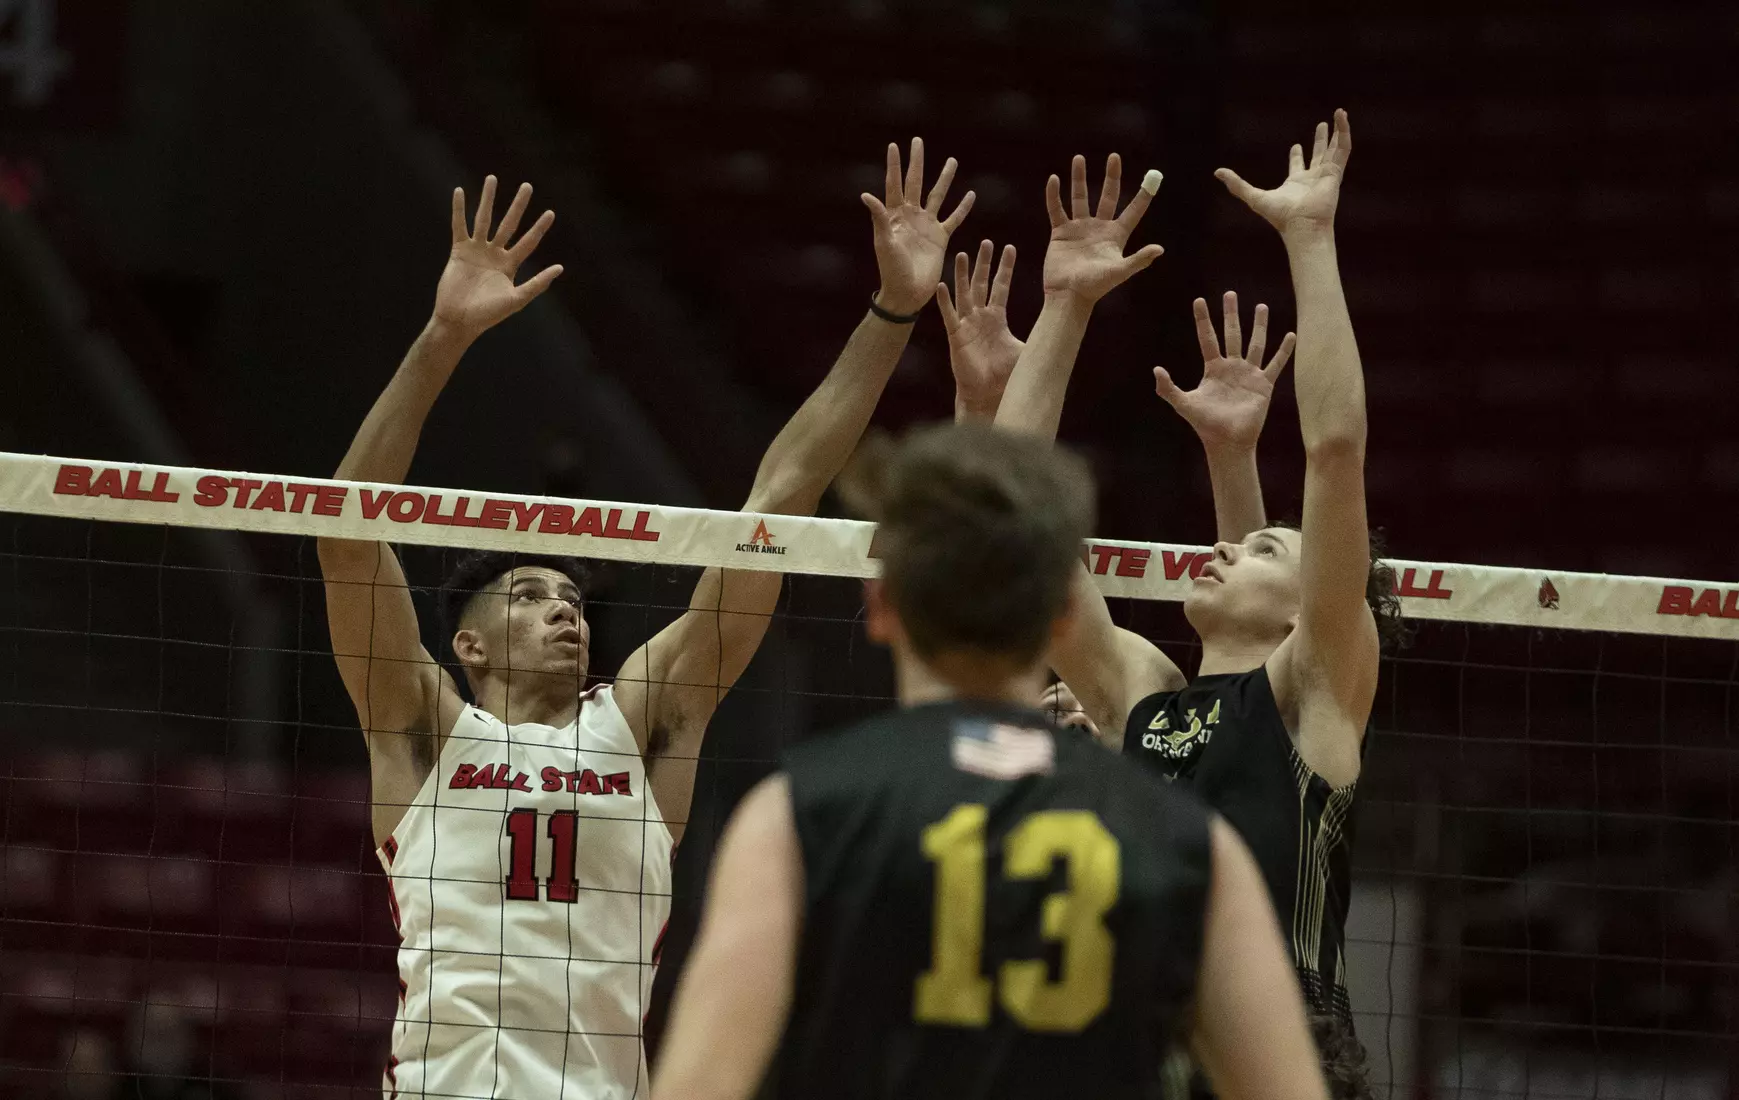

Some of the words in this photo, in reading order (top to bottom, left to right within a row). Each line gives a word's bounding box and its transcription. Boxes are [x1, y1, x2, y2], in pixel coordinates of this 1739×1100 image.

[53, 464, 180, 503] BALL
[193, 475, 349, 517] STATE
[359, 489, 660, 542] VOLLEYBALL
[735, 543, 760, 553] ACTIVE
[761, 545, 787, 555] ANKLE
[1391, 567, 1453, 600] LL
[449, 763, 534, 793] BALL
[540, 766, 633, 797] STATE
[505, 807, 579, 904] 11
[912, 802, 1122, 1035] 13
